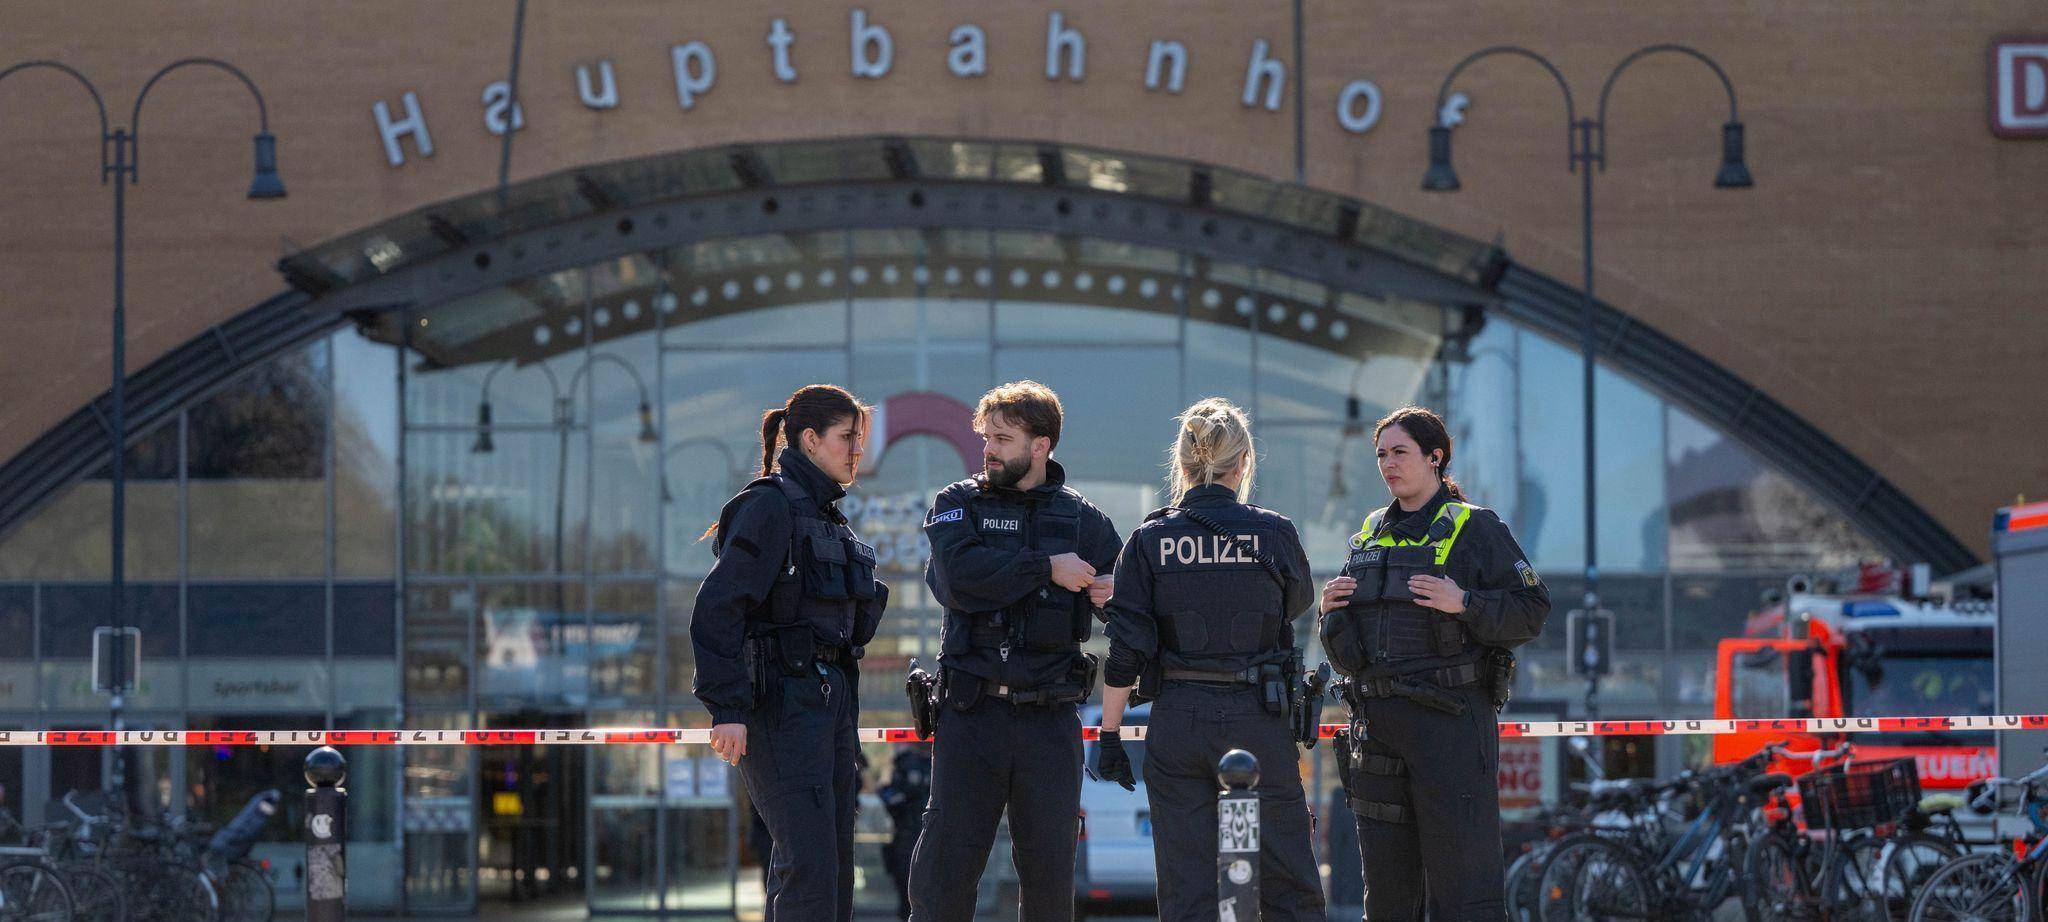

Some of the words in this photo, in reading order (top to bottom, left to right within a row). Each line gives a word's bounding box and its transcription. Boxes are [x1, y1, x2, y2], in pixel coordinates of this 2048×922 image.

[983, 518, 1018, 530] POLIZEI
[1160, 534, 1260, 567] POLIZEI
[1353, 550, 1380, 565] POLIZEI
